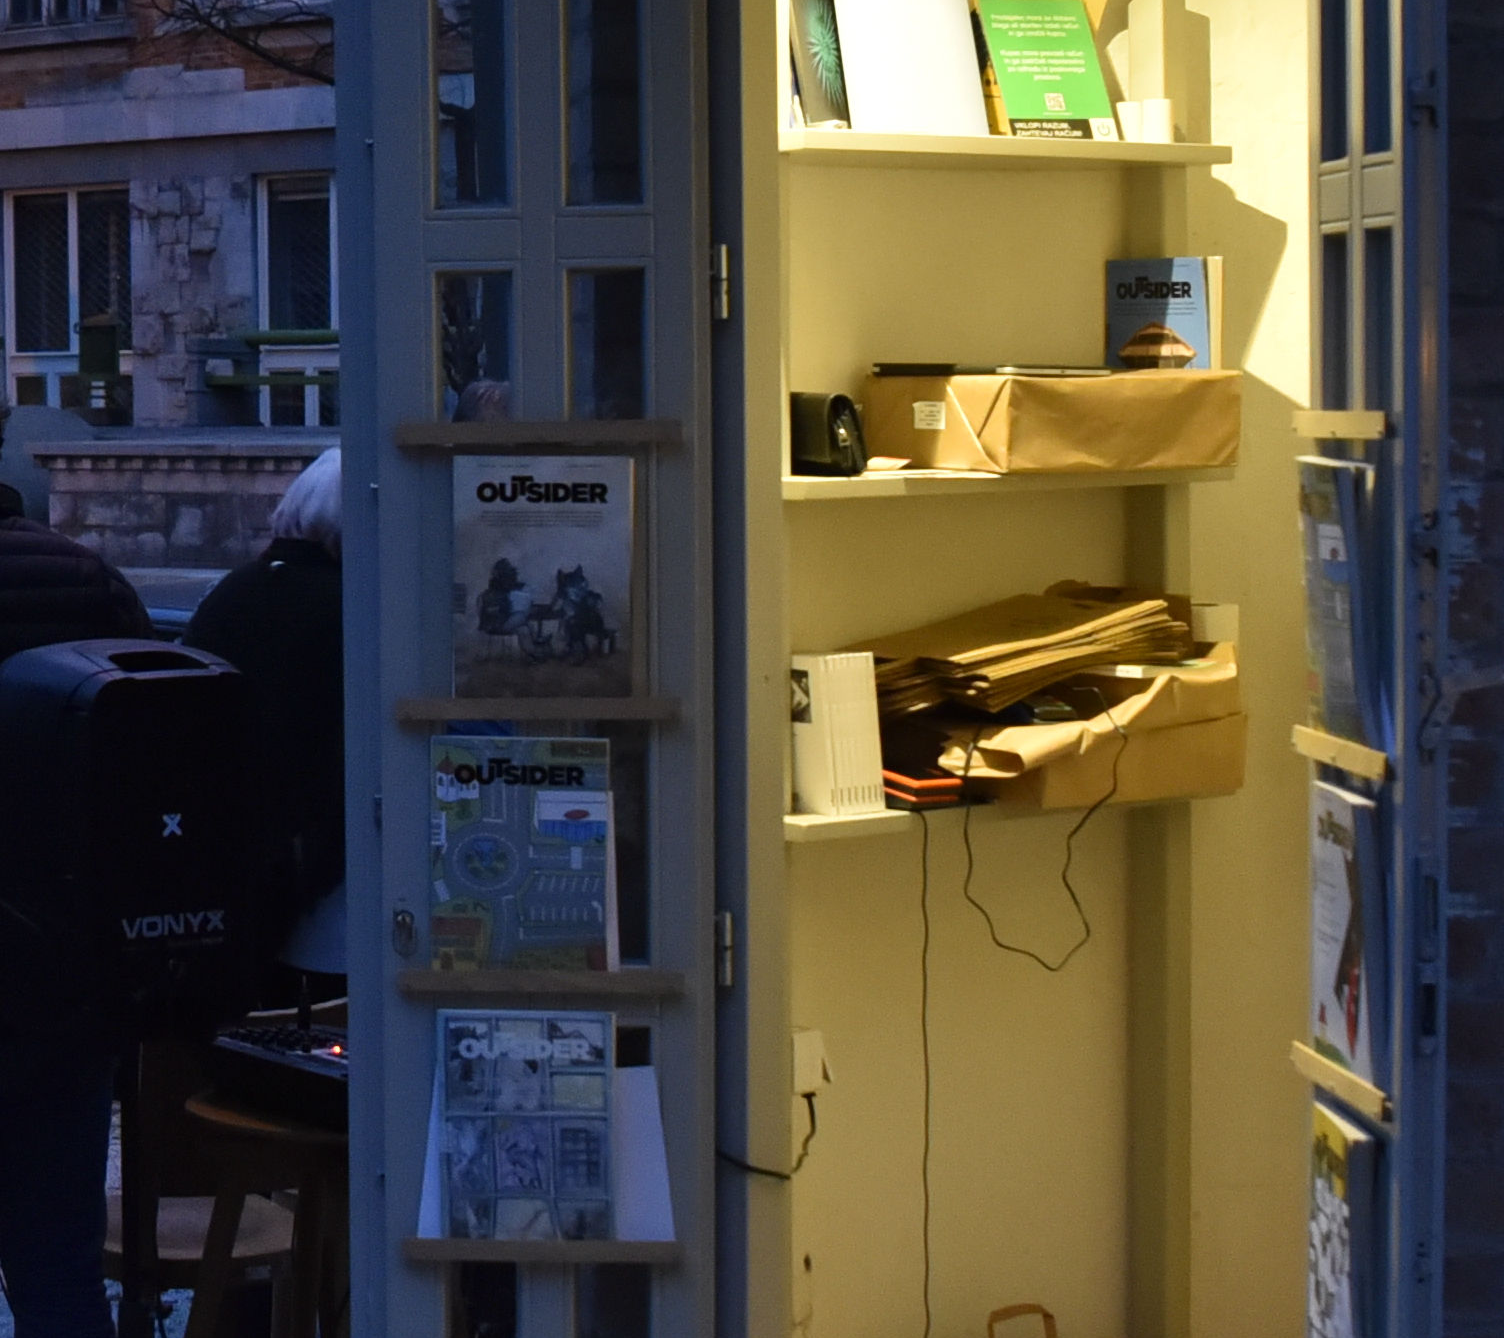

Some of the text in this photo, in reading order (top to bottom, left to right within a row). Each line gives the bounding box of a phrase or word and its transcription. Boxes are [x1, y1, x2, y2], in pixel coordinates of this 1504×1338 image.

[1116, 276, 1192, 299] OUTSIDER
[476, 476, 608, 503] OUTSIDER
[454, 758, 585, 786] OUTSIDER
[121, 910, 225, 939] VONYX
